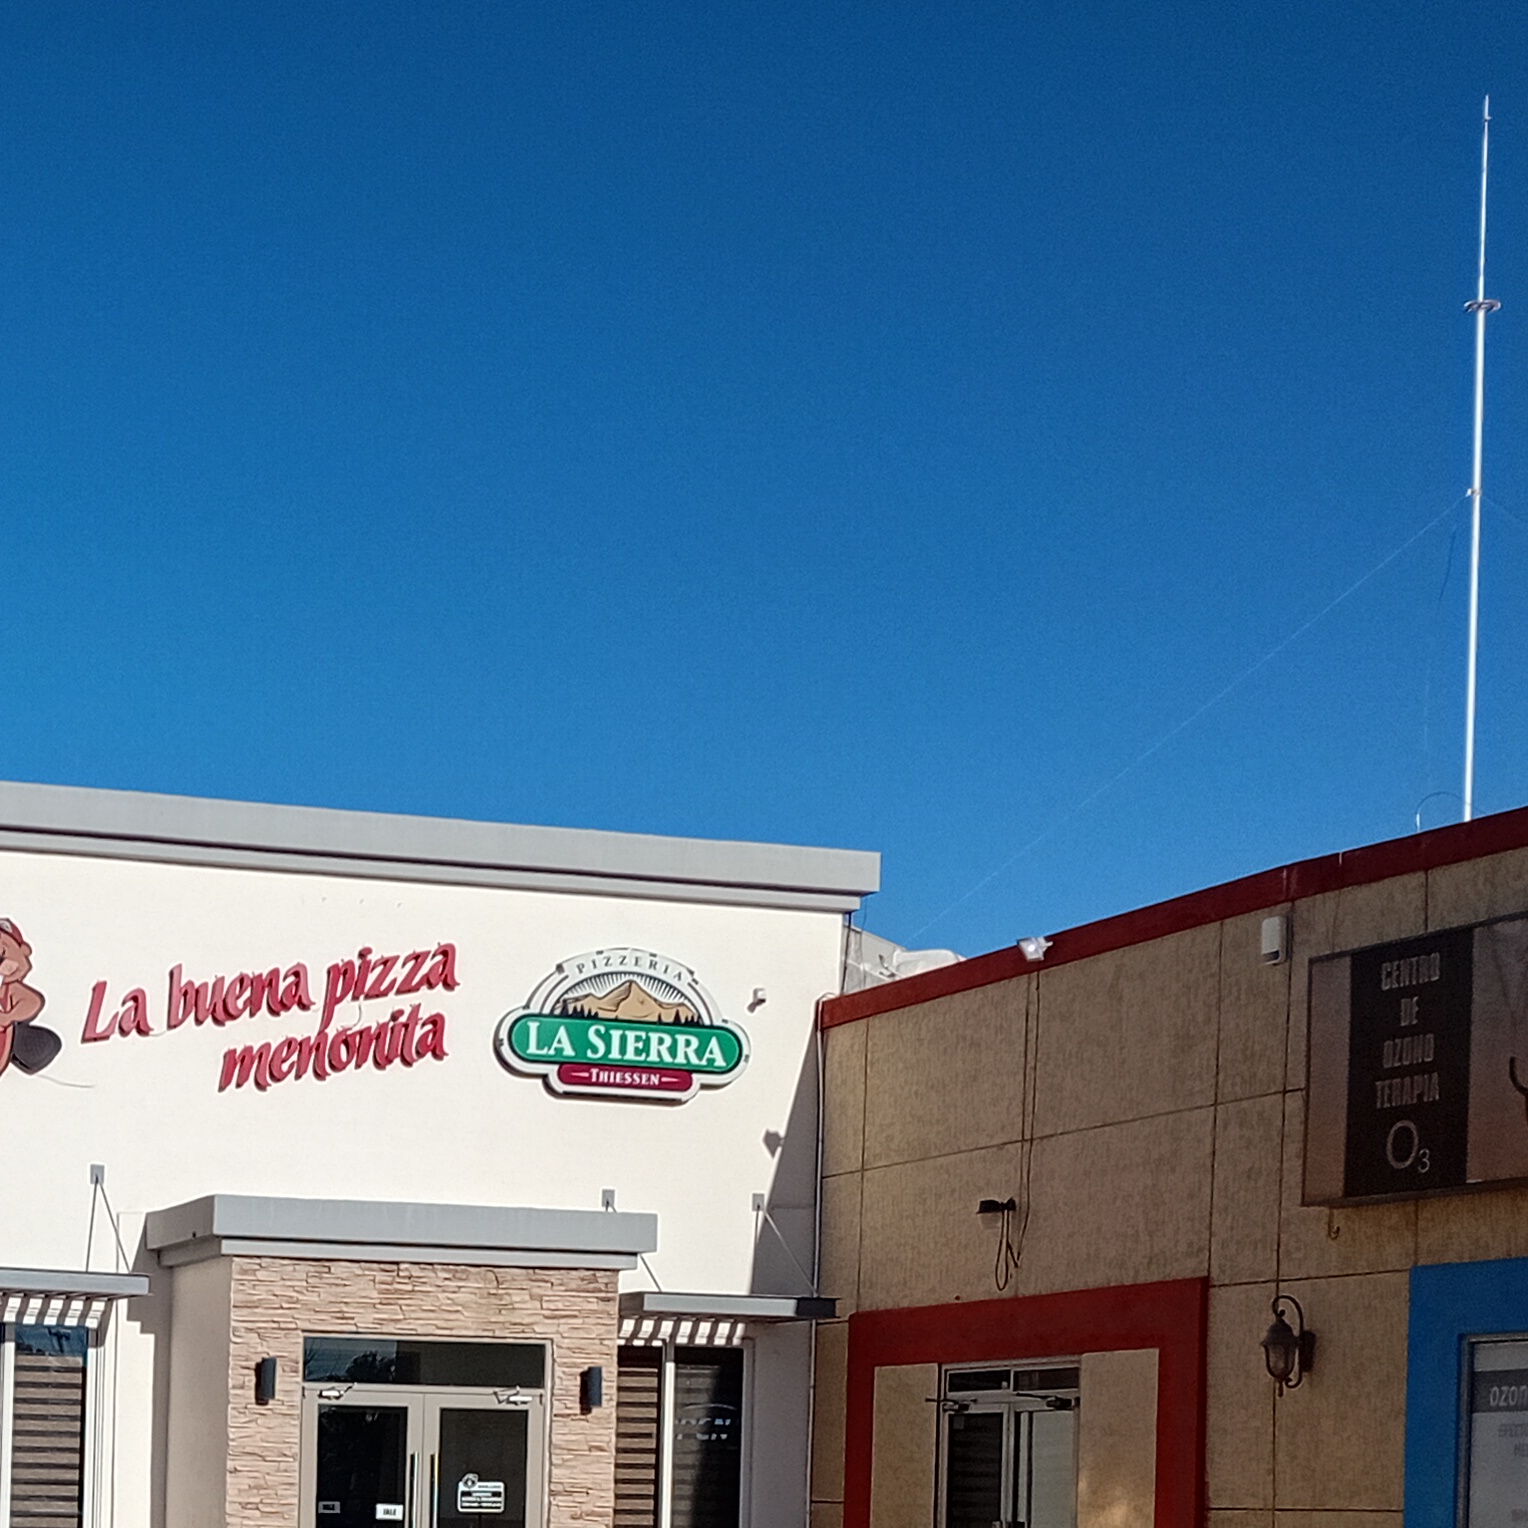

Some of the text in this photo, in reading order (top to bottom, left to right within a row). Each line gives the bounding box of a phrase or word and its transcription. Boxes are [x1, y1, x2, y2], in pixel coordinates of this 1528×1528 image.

[576, 955, 684, 982] PIZZERIA
[80, 942, 460, 1045] La buena pizza
[218, 1002, 449, 1092] menonita
[526, 1021, 727, 1067] LA SIERRA
[589, 1068, 660, 1086] THIESSEN
